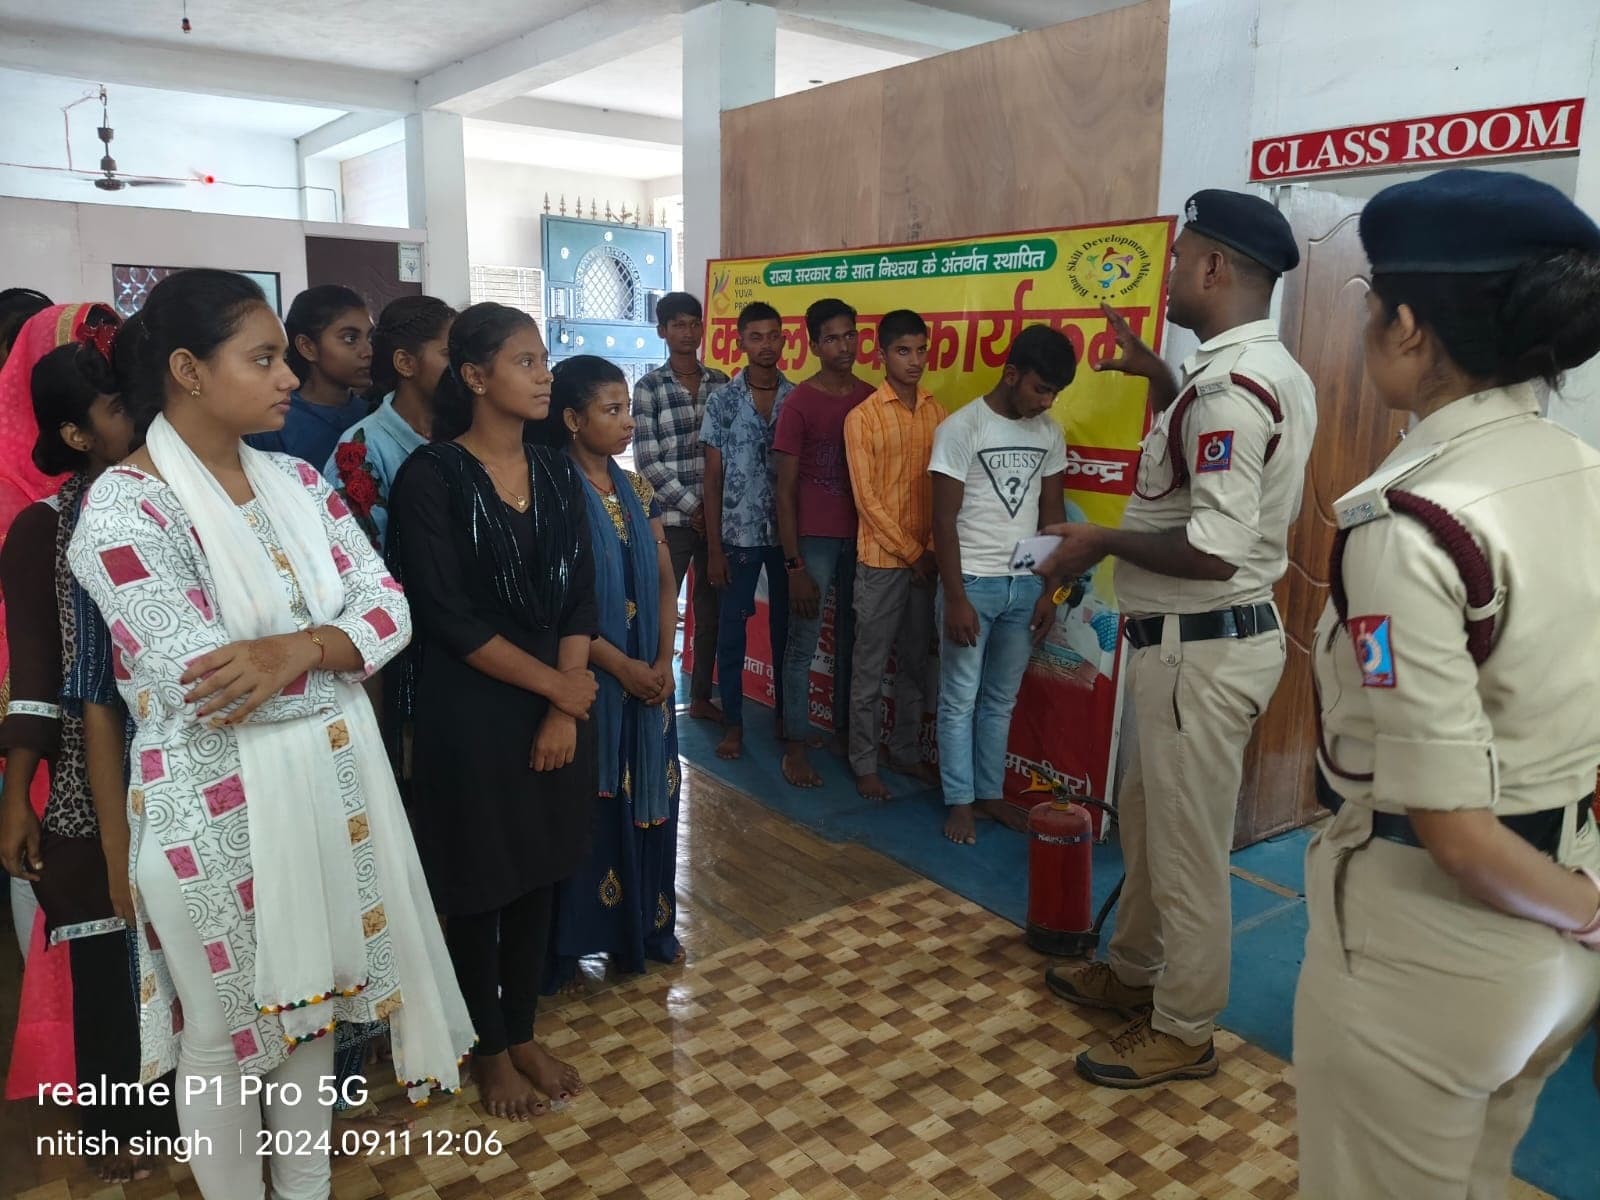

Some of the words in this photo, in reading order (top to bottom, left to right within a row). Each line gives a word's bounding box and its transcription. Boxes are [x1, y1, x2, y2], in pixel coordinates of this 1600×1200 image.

[1257, 128, 1390, 176] CLASS
[1402, 104, 1576, 160] ROOM
[1082, 234, 1149, 260] Development
[769, 269, 793, 285] राज्य
[795, 266, 832, 283] सरकार
[834, 259, 849, 280] के
[851, 263, 874, 280] सात
[878, 256, 918, 278] निश्चय
[922, 252, 937, 275] के
[941, 247, 988, 273] अंतर्गत
[993, 244, 1046, 270] स्थापित
[1066, 250, 1083, 272] Skill
[734, 273, 762, 285] KUSHAL
[1068, 274, 1089, 297] Bihar
[1120, 262, 1151, 295] Mission
[734, 287, 753, 298] YUVA
[989, 452, 1037, 470] GUESS
